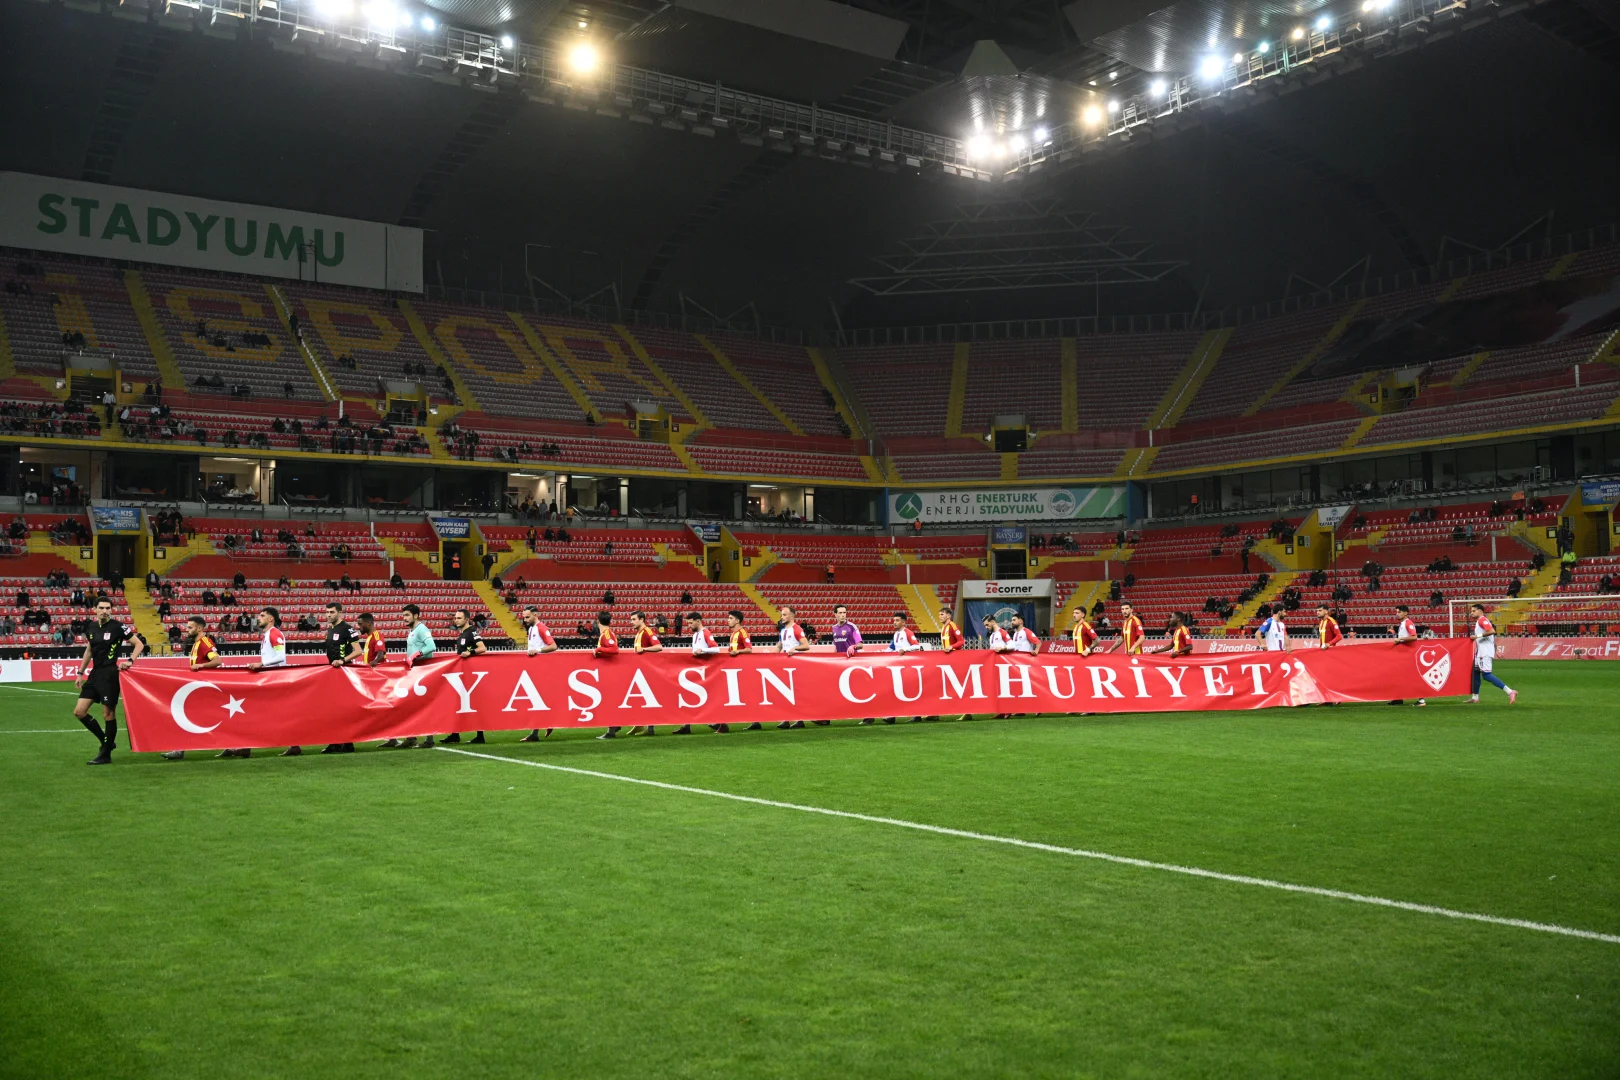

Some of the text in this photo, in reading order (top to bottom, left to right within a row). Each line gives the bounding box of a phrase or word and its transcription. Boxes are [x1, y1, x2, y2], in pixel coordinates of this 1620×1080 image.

[36, 193, 345, 267] STADYUMU
[940, 492, 1038, 503] RHG ENERTÜRK
[926, 504, 1045, 516] ENERJİ STADYUMU
[1216, 643, 1244, 653] Ziraat
